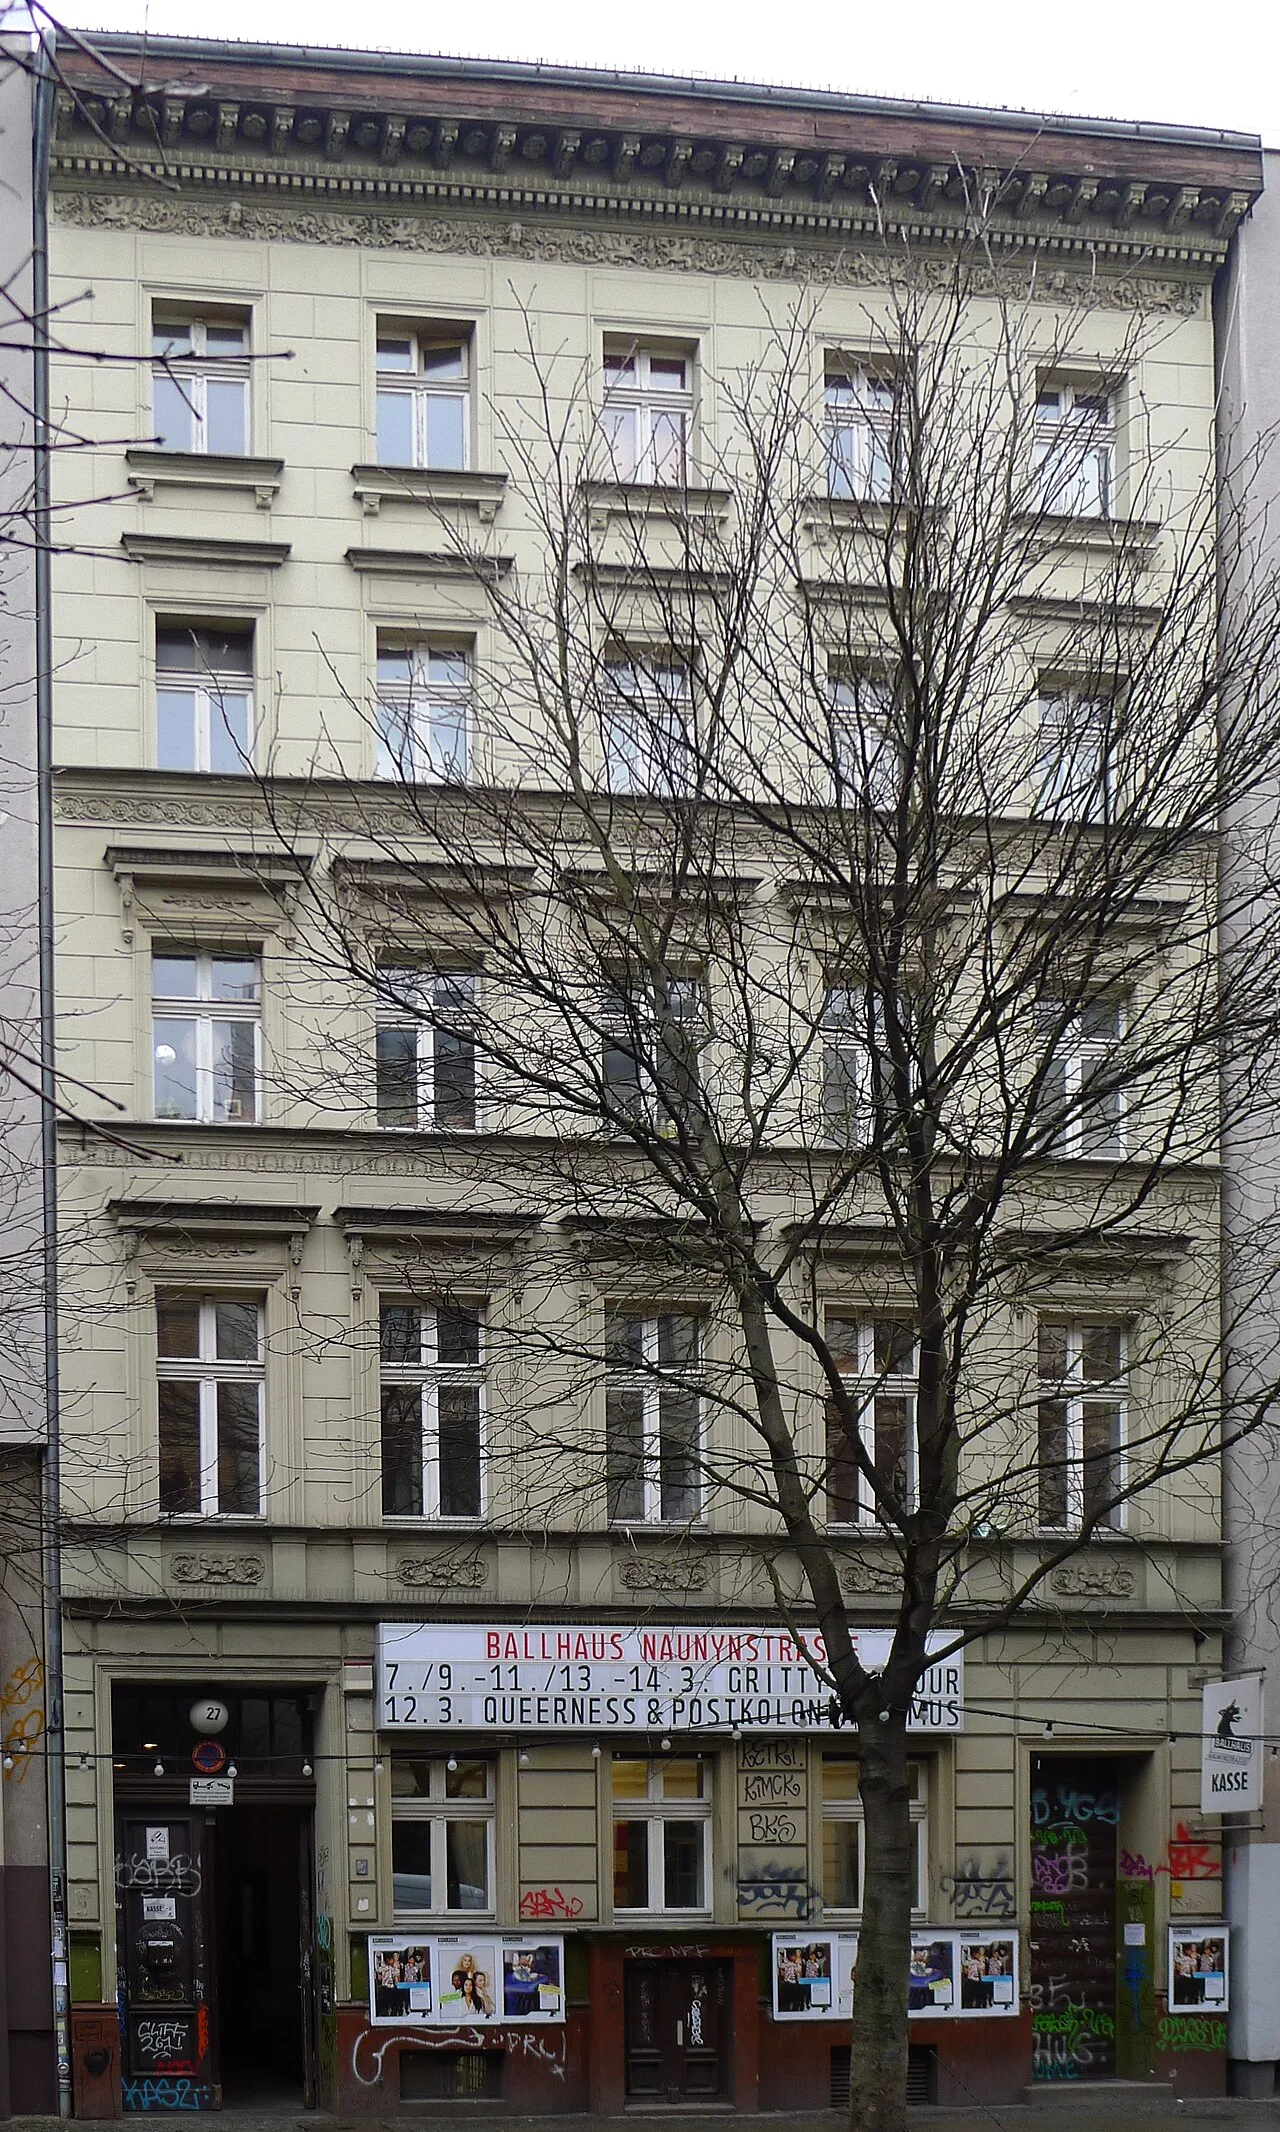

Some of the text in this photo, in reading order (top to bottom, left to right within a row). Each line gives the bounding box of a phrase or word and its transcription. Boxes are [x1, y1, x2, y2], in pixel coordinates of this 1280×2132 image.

[486, 1631, 859, 1662] BALLHAUS NAUNYNSTRAS
[206, 1706, 221, 1721] 27
[385, 1696, 463, 1724] 12.3.
[484, 1697, 636, 1725] QUEERNESS
[647, 1698, 664, 1725] &
[1211, 1771, 1249, 1793] KASSE
